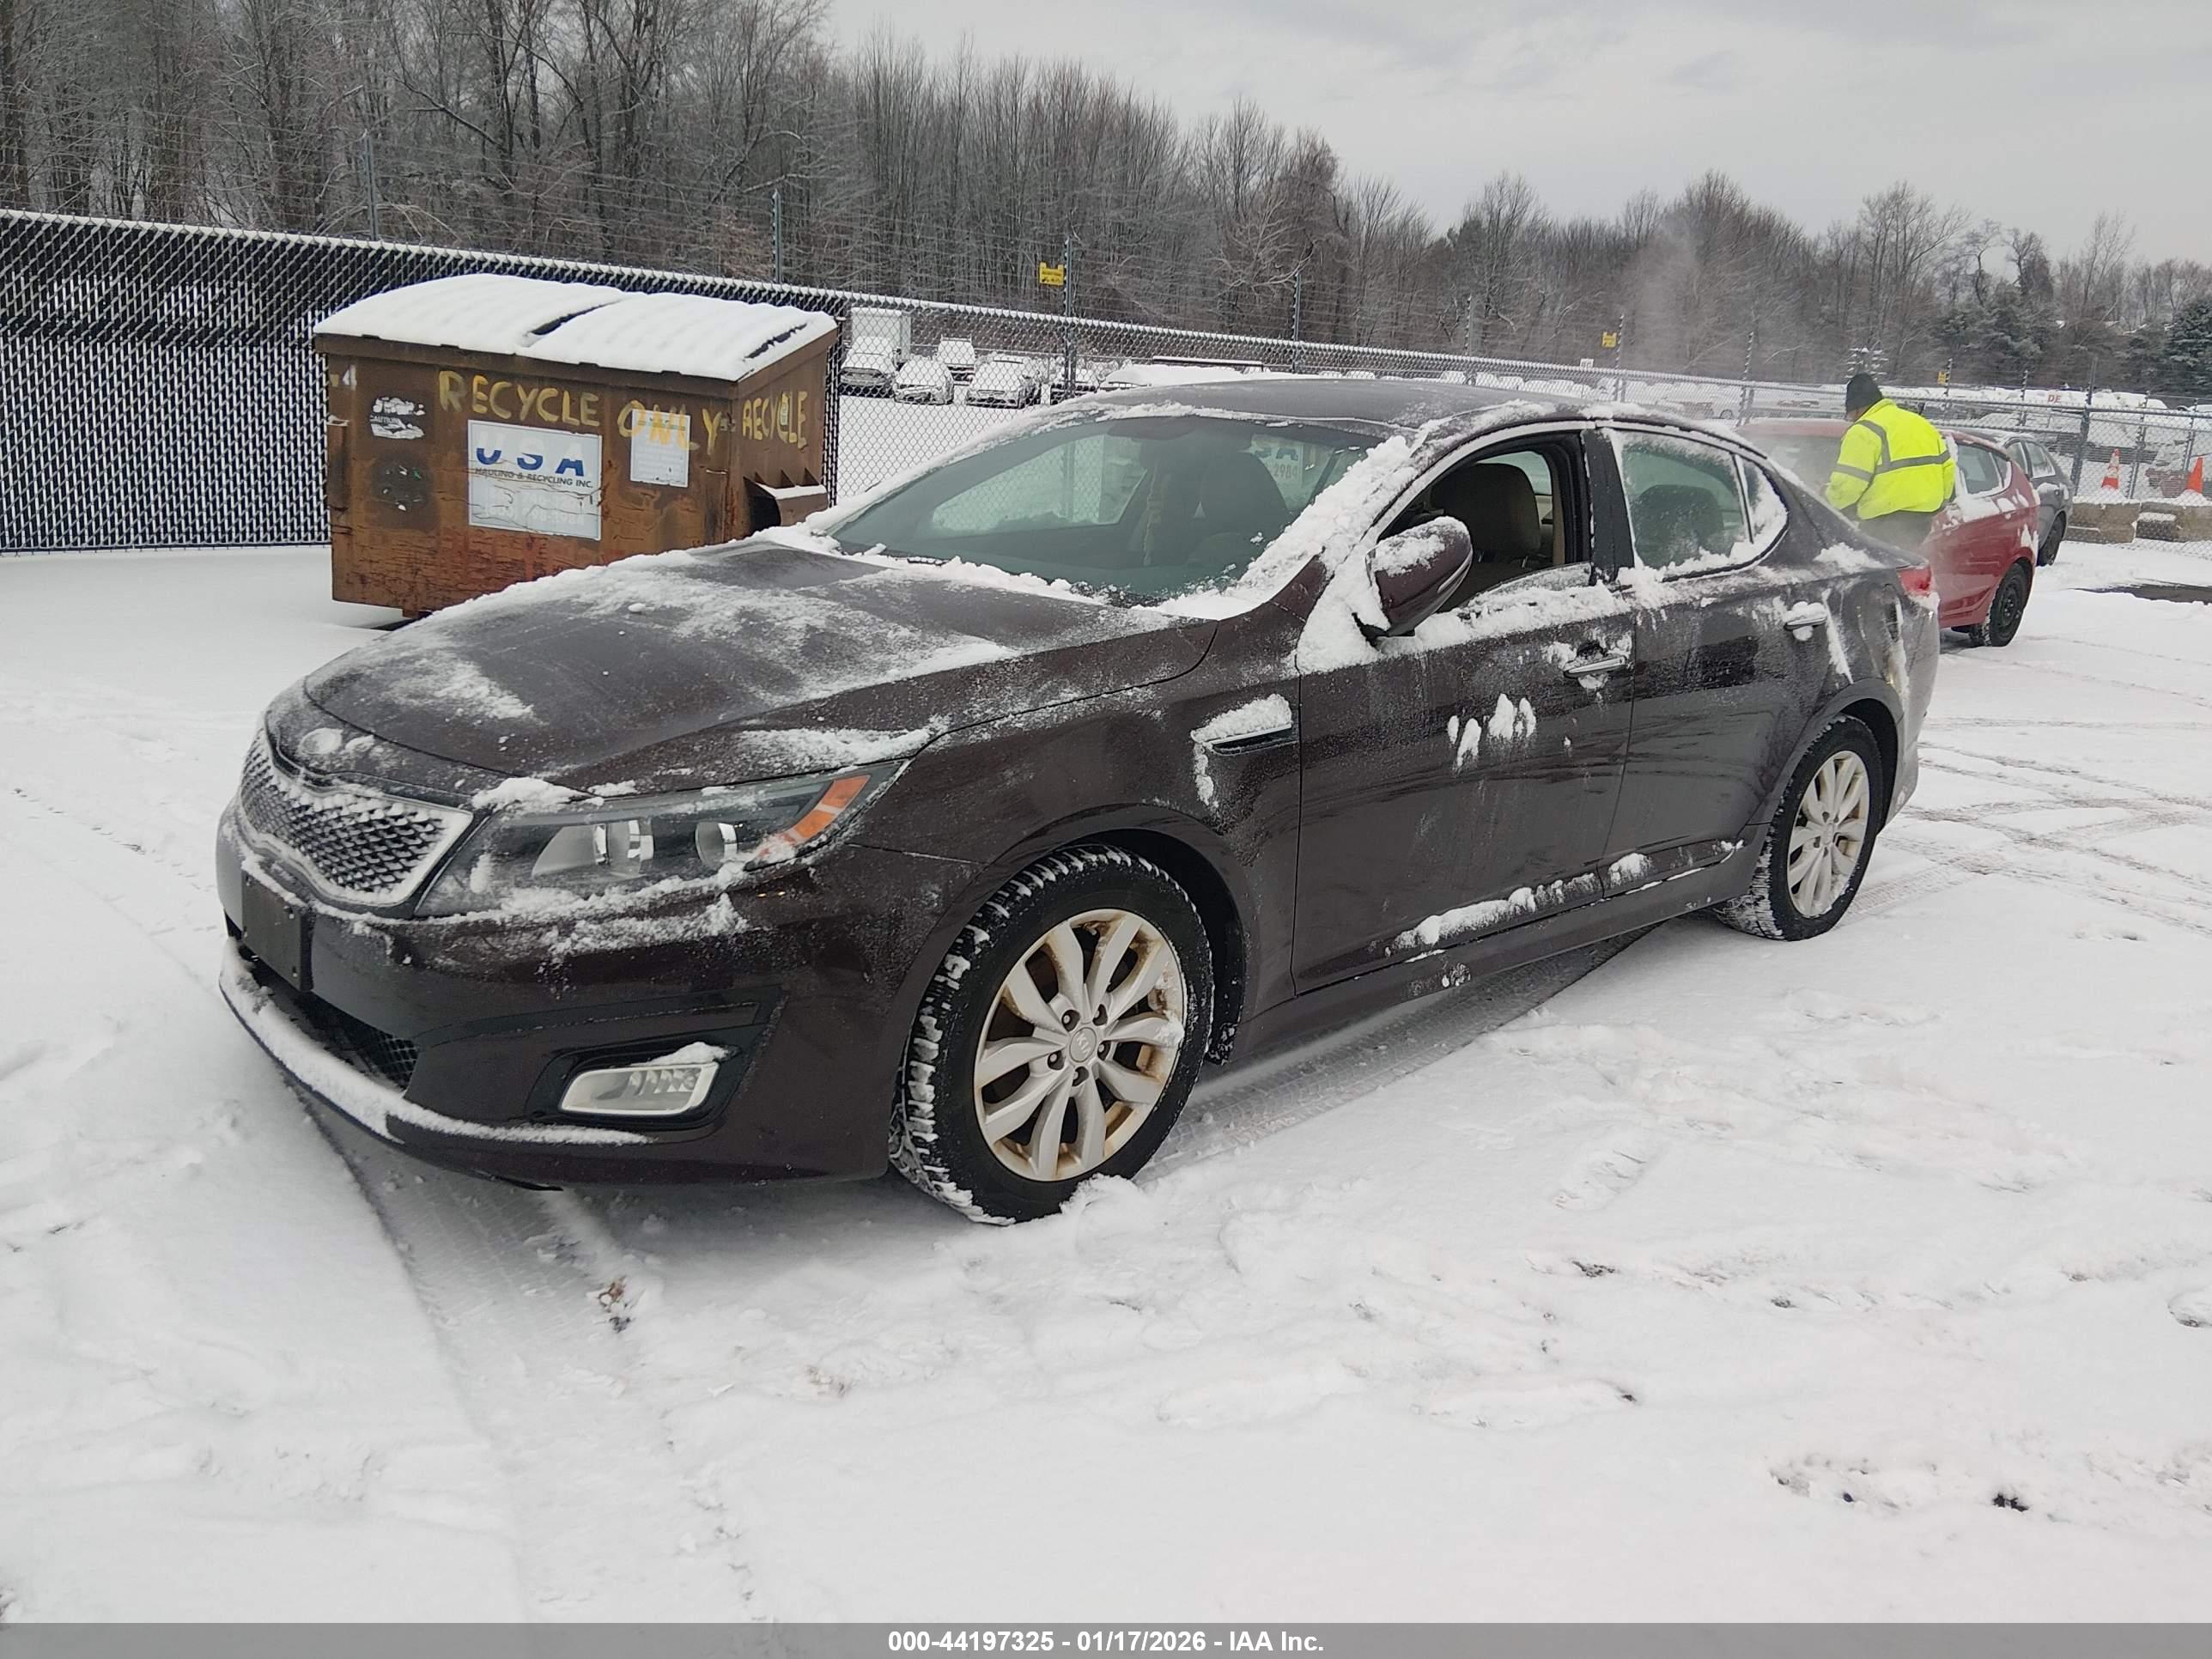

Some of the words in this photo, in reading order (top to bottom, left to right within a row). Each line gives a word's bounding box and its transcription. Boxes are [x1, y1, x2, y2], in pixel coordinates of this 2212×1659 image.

[439, 370, 599, 427] RECYCLE
[617, 399, 722, 456] ONLY
[527, 474, 573, 486] RECYCLING
[575, 479, 593, 489] INC.
